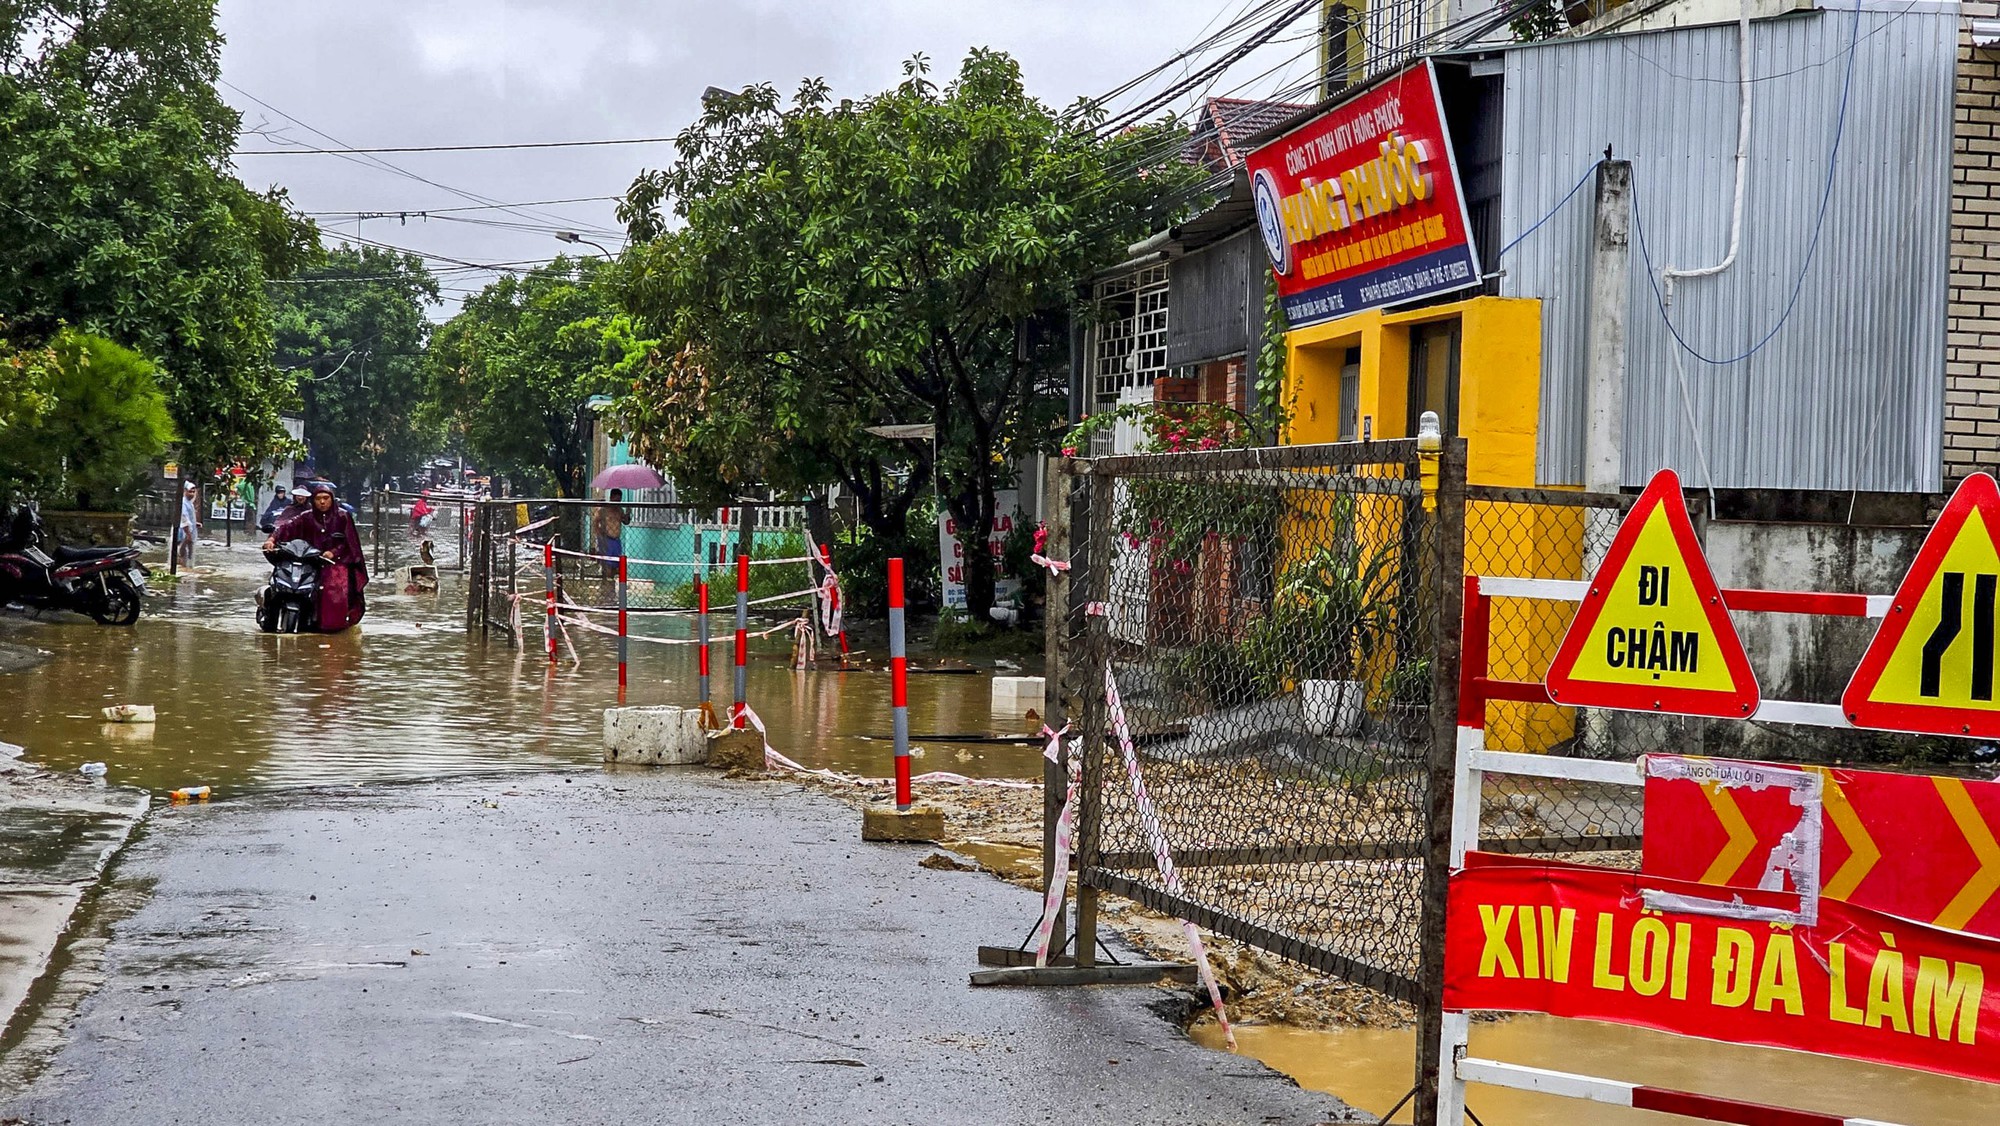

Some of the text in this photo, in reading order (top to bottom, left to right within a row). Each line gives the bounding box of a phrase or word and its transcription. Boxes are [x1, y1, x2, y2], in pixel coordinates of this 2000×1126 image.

[1285, 144, 1307, 176] CÔNG
[1305, 140, 1317, 166] TY
[1315, 131, 1338, 162] TNHH
[1334, 123, 1353, 153] MTV
[1281, 178, 1349, 245] HƯNG
[1340, 131, 1430, 223] PHƯỚC
[1638, 565, 1669, 607] ĐI
[1606, 620, 1699, 680] CHẬM
[1755, 773, 1764, 783] ĐI
[1477, 904, 1576, 984] XIN
[1711, 920, 1805, 1016] ĐÃ
[1829, 931, 1985, 1046] LÀM
